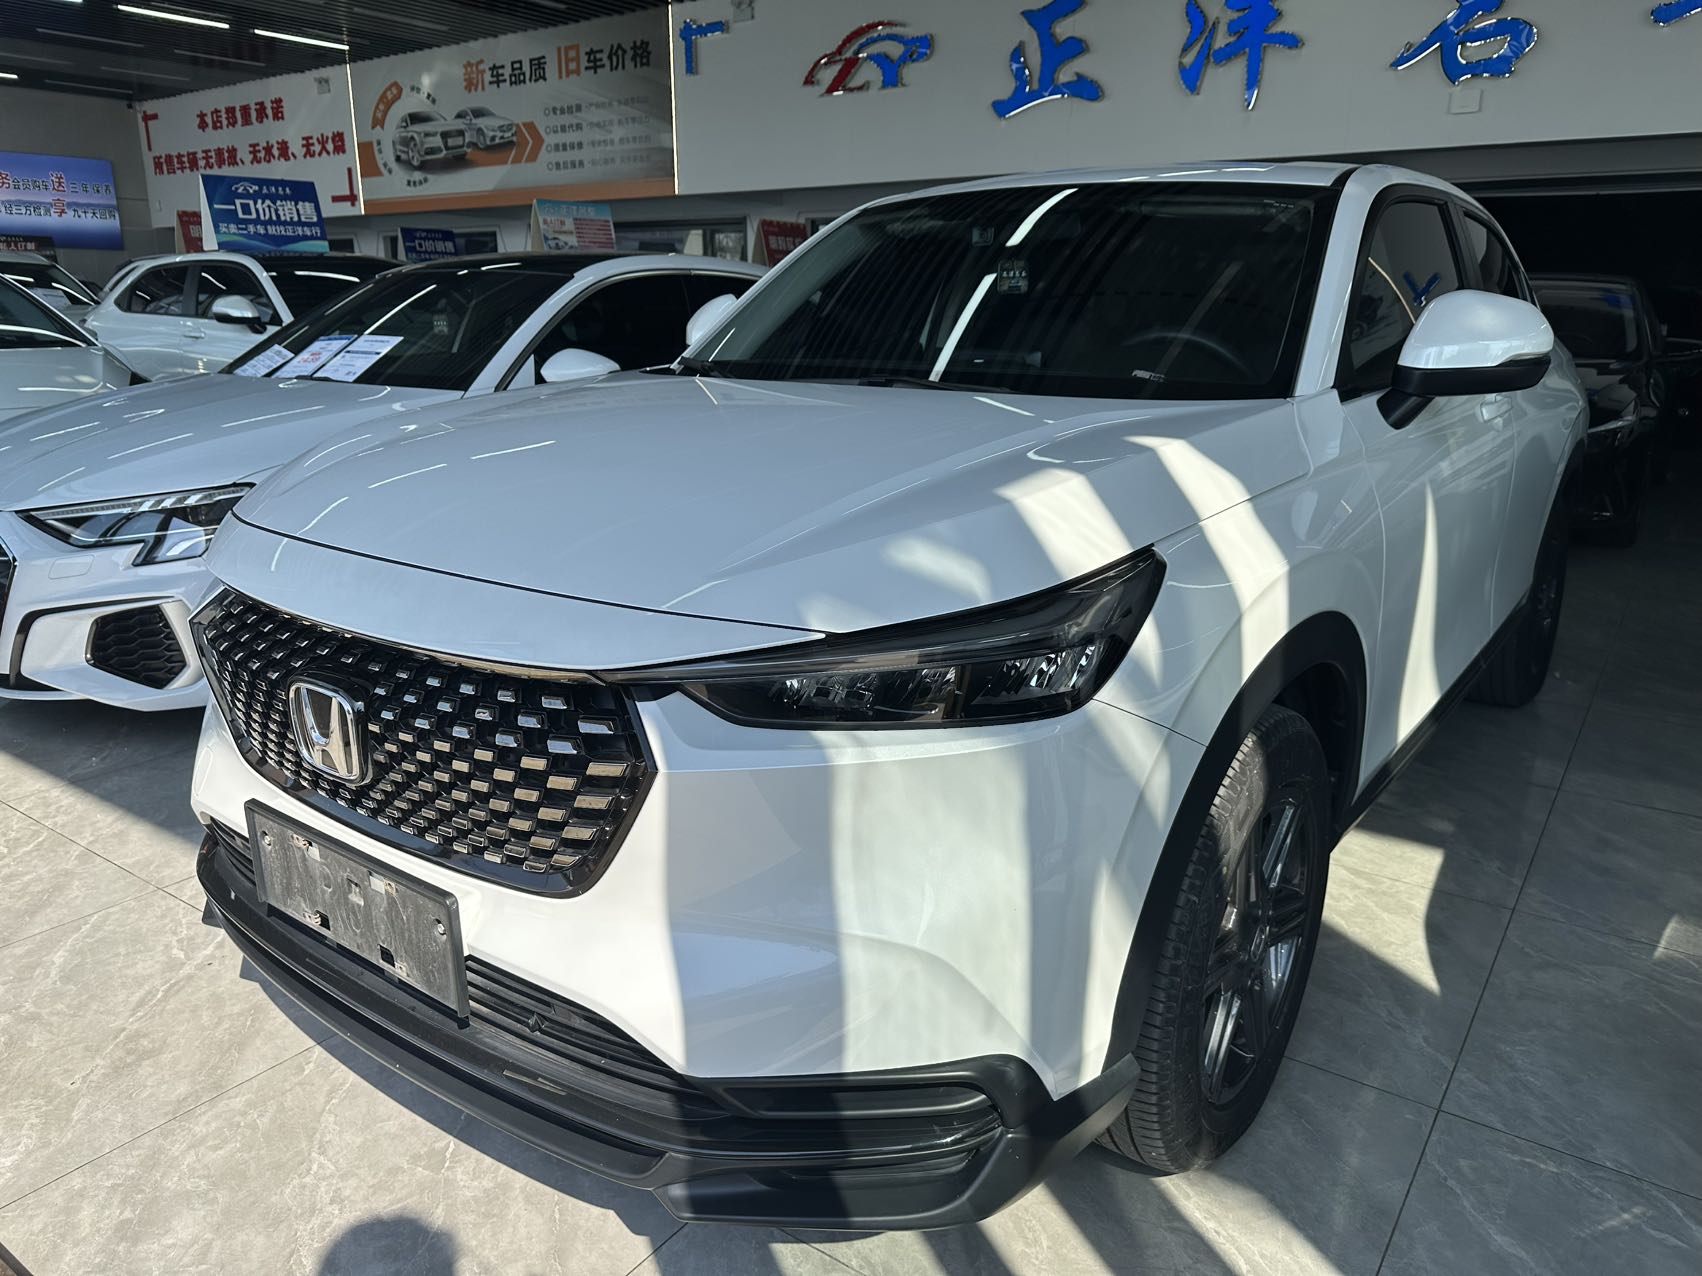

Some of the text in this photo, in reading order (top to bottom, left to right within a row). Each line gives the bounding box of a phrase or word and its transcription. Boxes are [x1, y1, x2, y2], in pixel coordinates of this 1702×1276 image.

[462, 39, 652, 95] 新车品质 旧车价格
[196, 96, 286, 133] 本店郑重承诺
[213, 198, 318, 223] 一口价销售
[218, 222, 321, 238] 买卖二手车 就找正洋车行
